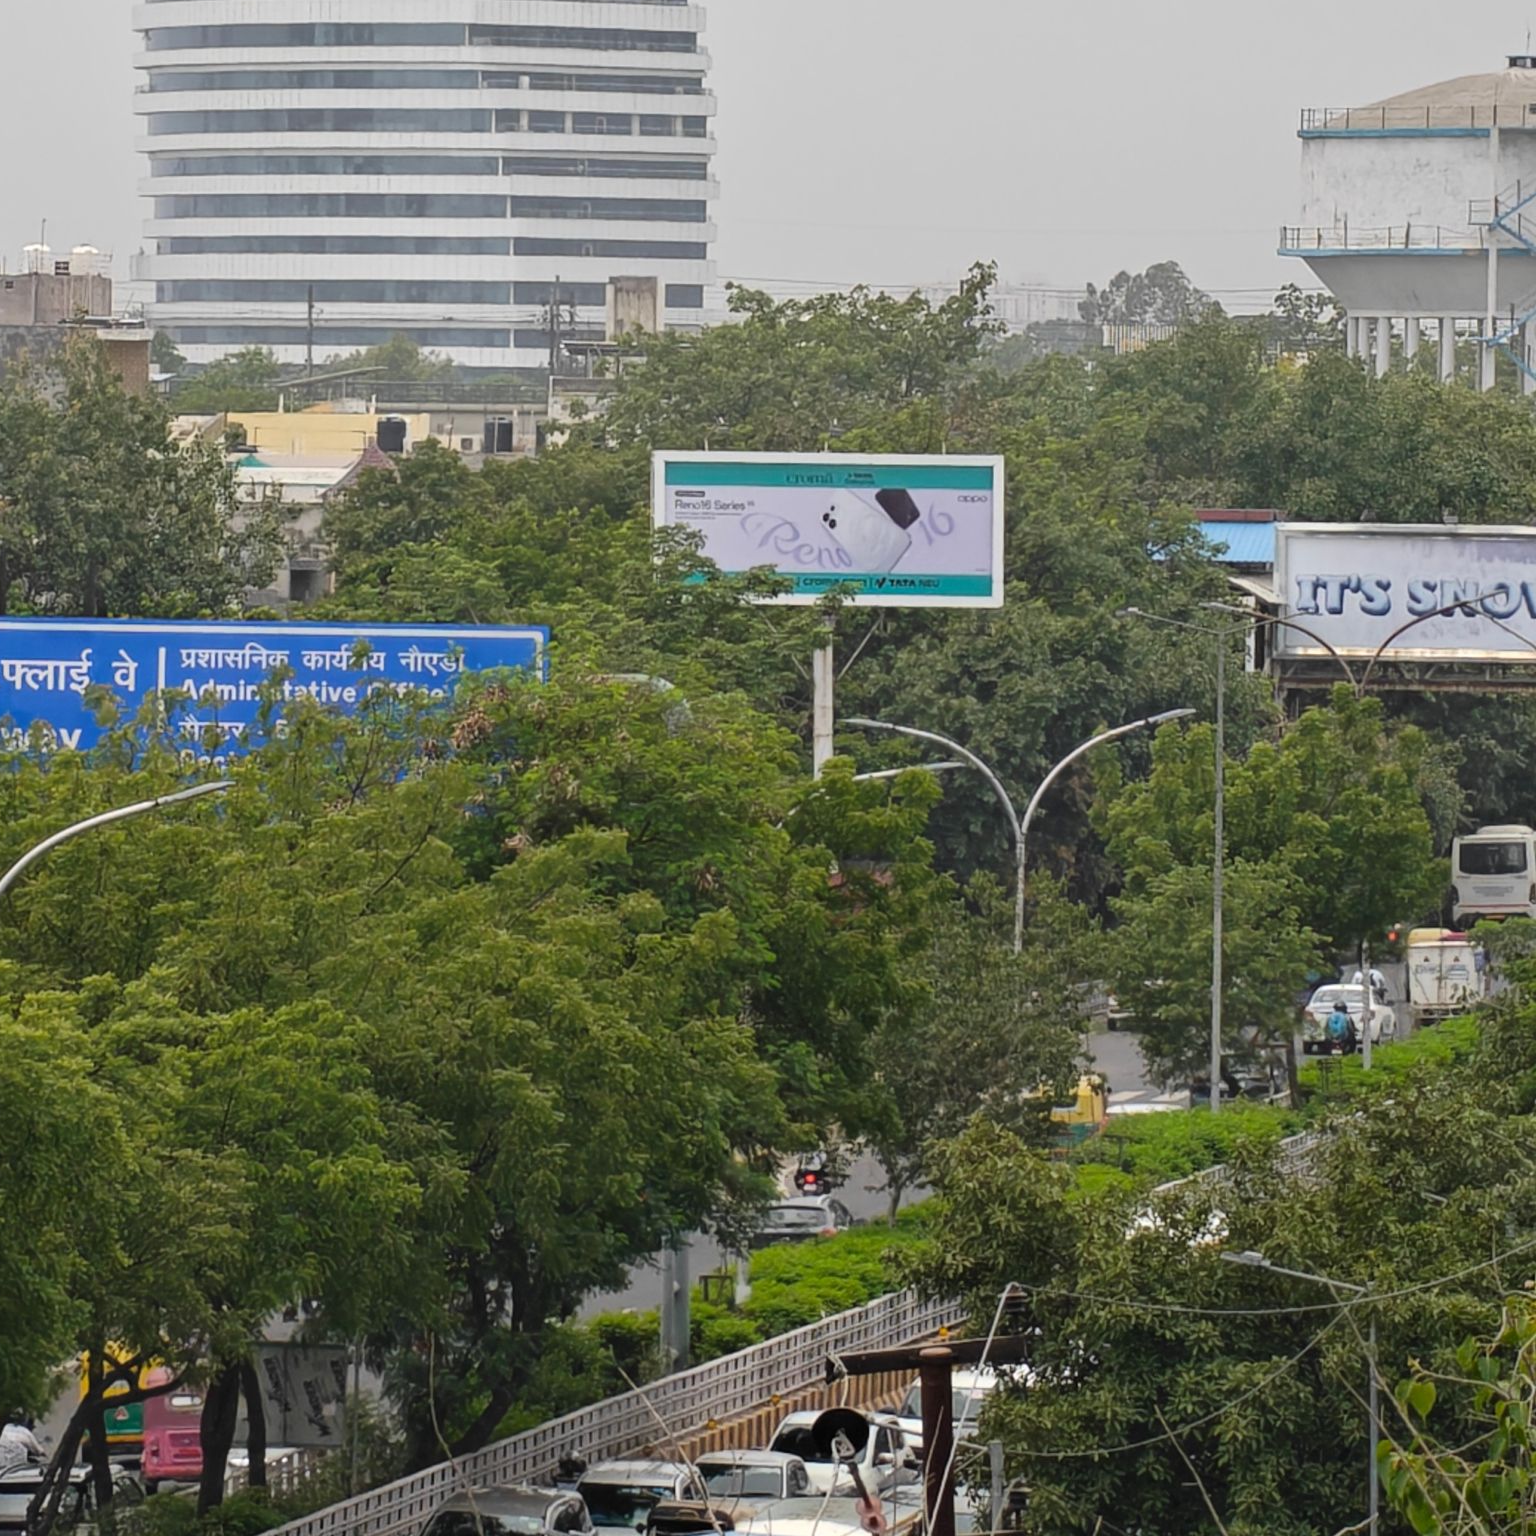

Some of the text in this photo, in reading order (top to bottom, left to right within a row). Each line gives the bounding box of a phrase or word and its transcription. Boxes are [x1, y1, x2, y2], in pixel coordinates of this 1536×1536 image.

[713, 500, 745, 511] Series
[889, 579, 916, 588] TATA
[1295, 574, 1391, 616] IT'S
[180, 642, 289, 670] प्रशासनिक
[112, 649, 138, 692] वे
